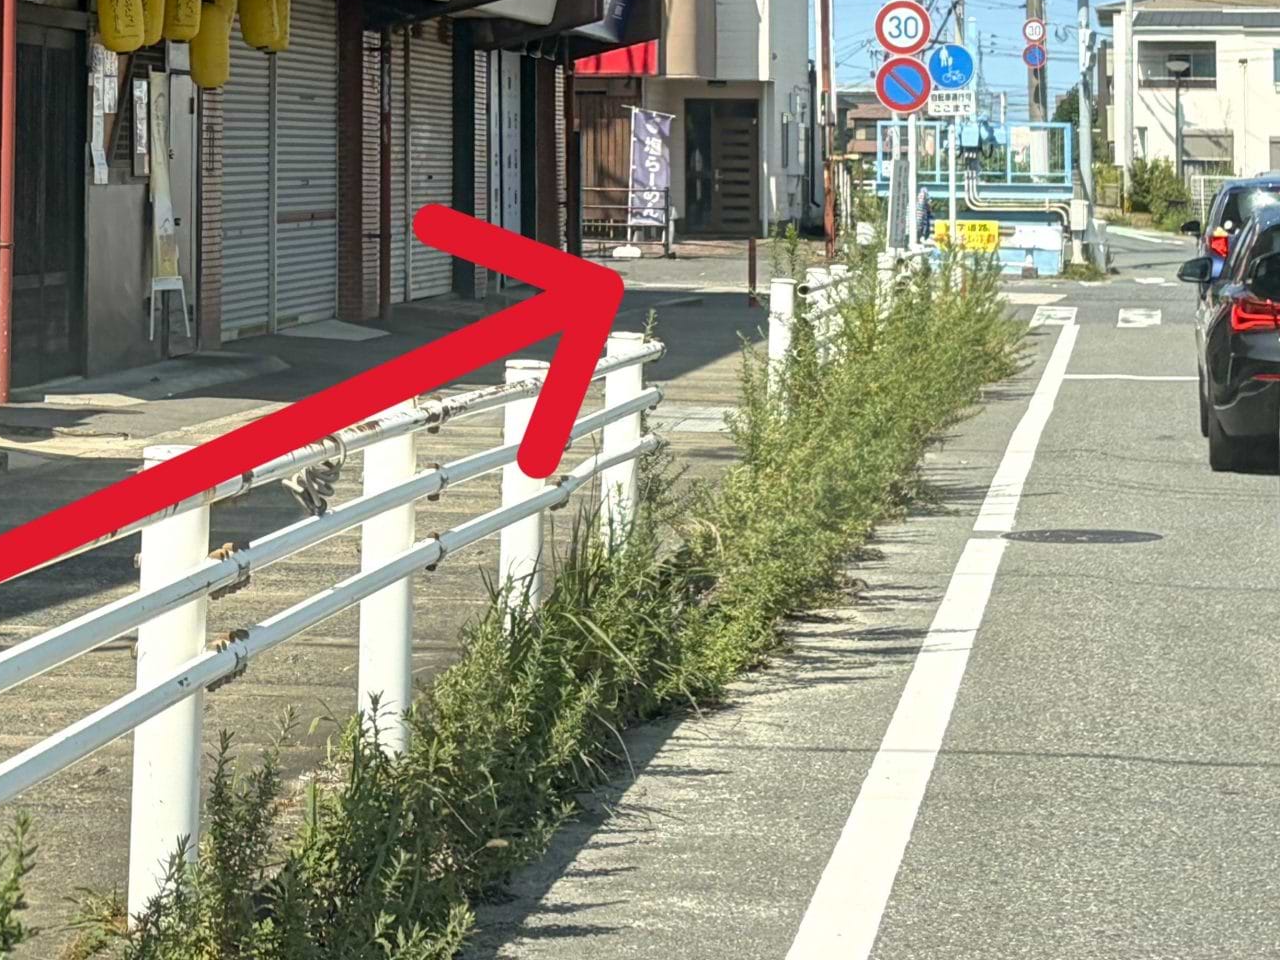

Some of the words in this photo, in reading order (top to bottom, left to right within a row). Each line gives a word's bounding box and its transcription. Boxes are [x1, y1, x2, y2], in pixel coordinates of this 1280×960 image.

[888, 16, 918, 39] 30
[1027, 24, 1042, 37] 30
[934, 104, 970, 113] ここまで
